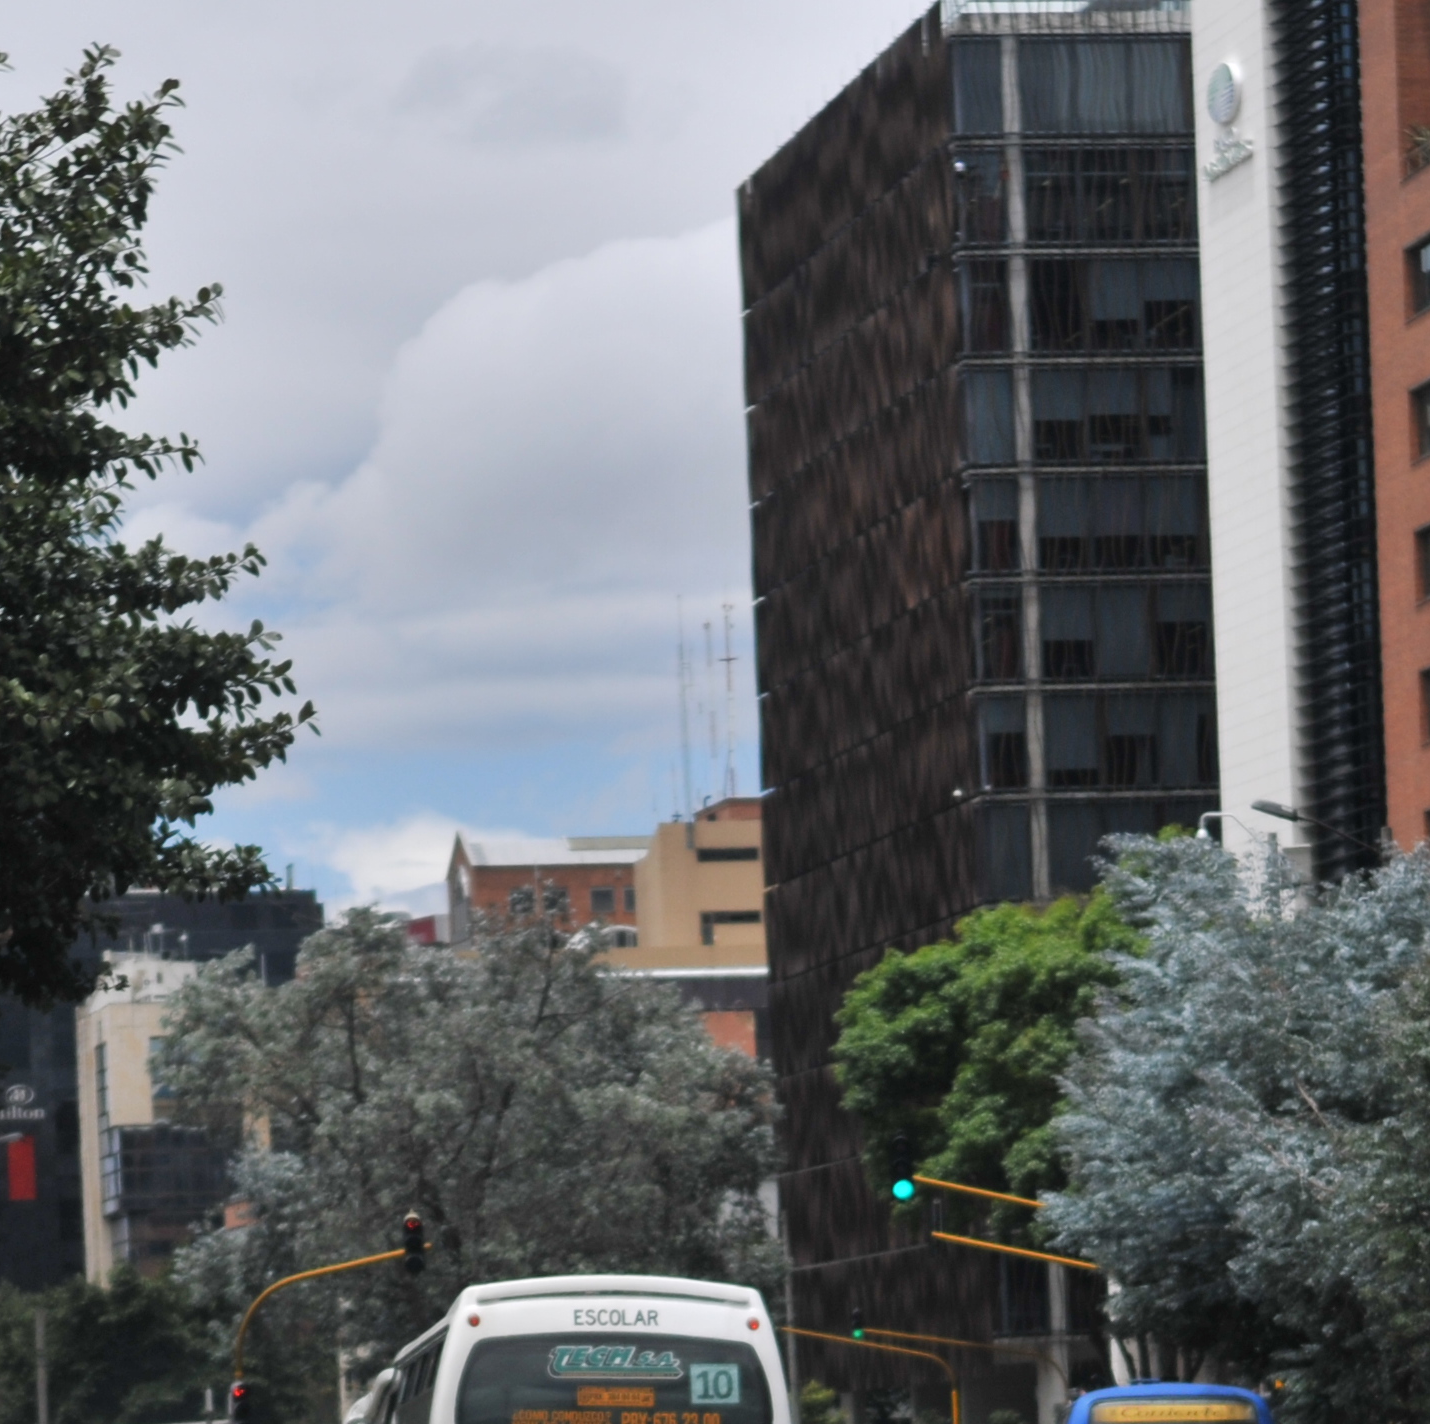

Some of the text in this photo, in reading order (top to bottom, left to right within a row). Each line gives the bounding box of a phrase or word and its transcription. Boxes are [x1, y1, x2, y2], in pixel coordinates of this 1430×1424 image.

[573, 1308, 659, 1327] ESCOLAR
[553, 1345, 636, 1367] TECH
[695, 1369, 733, 1400] 10
